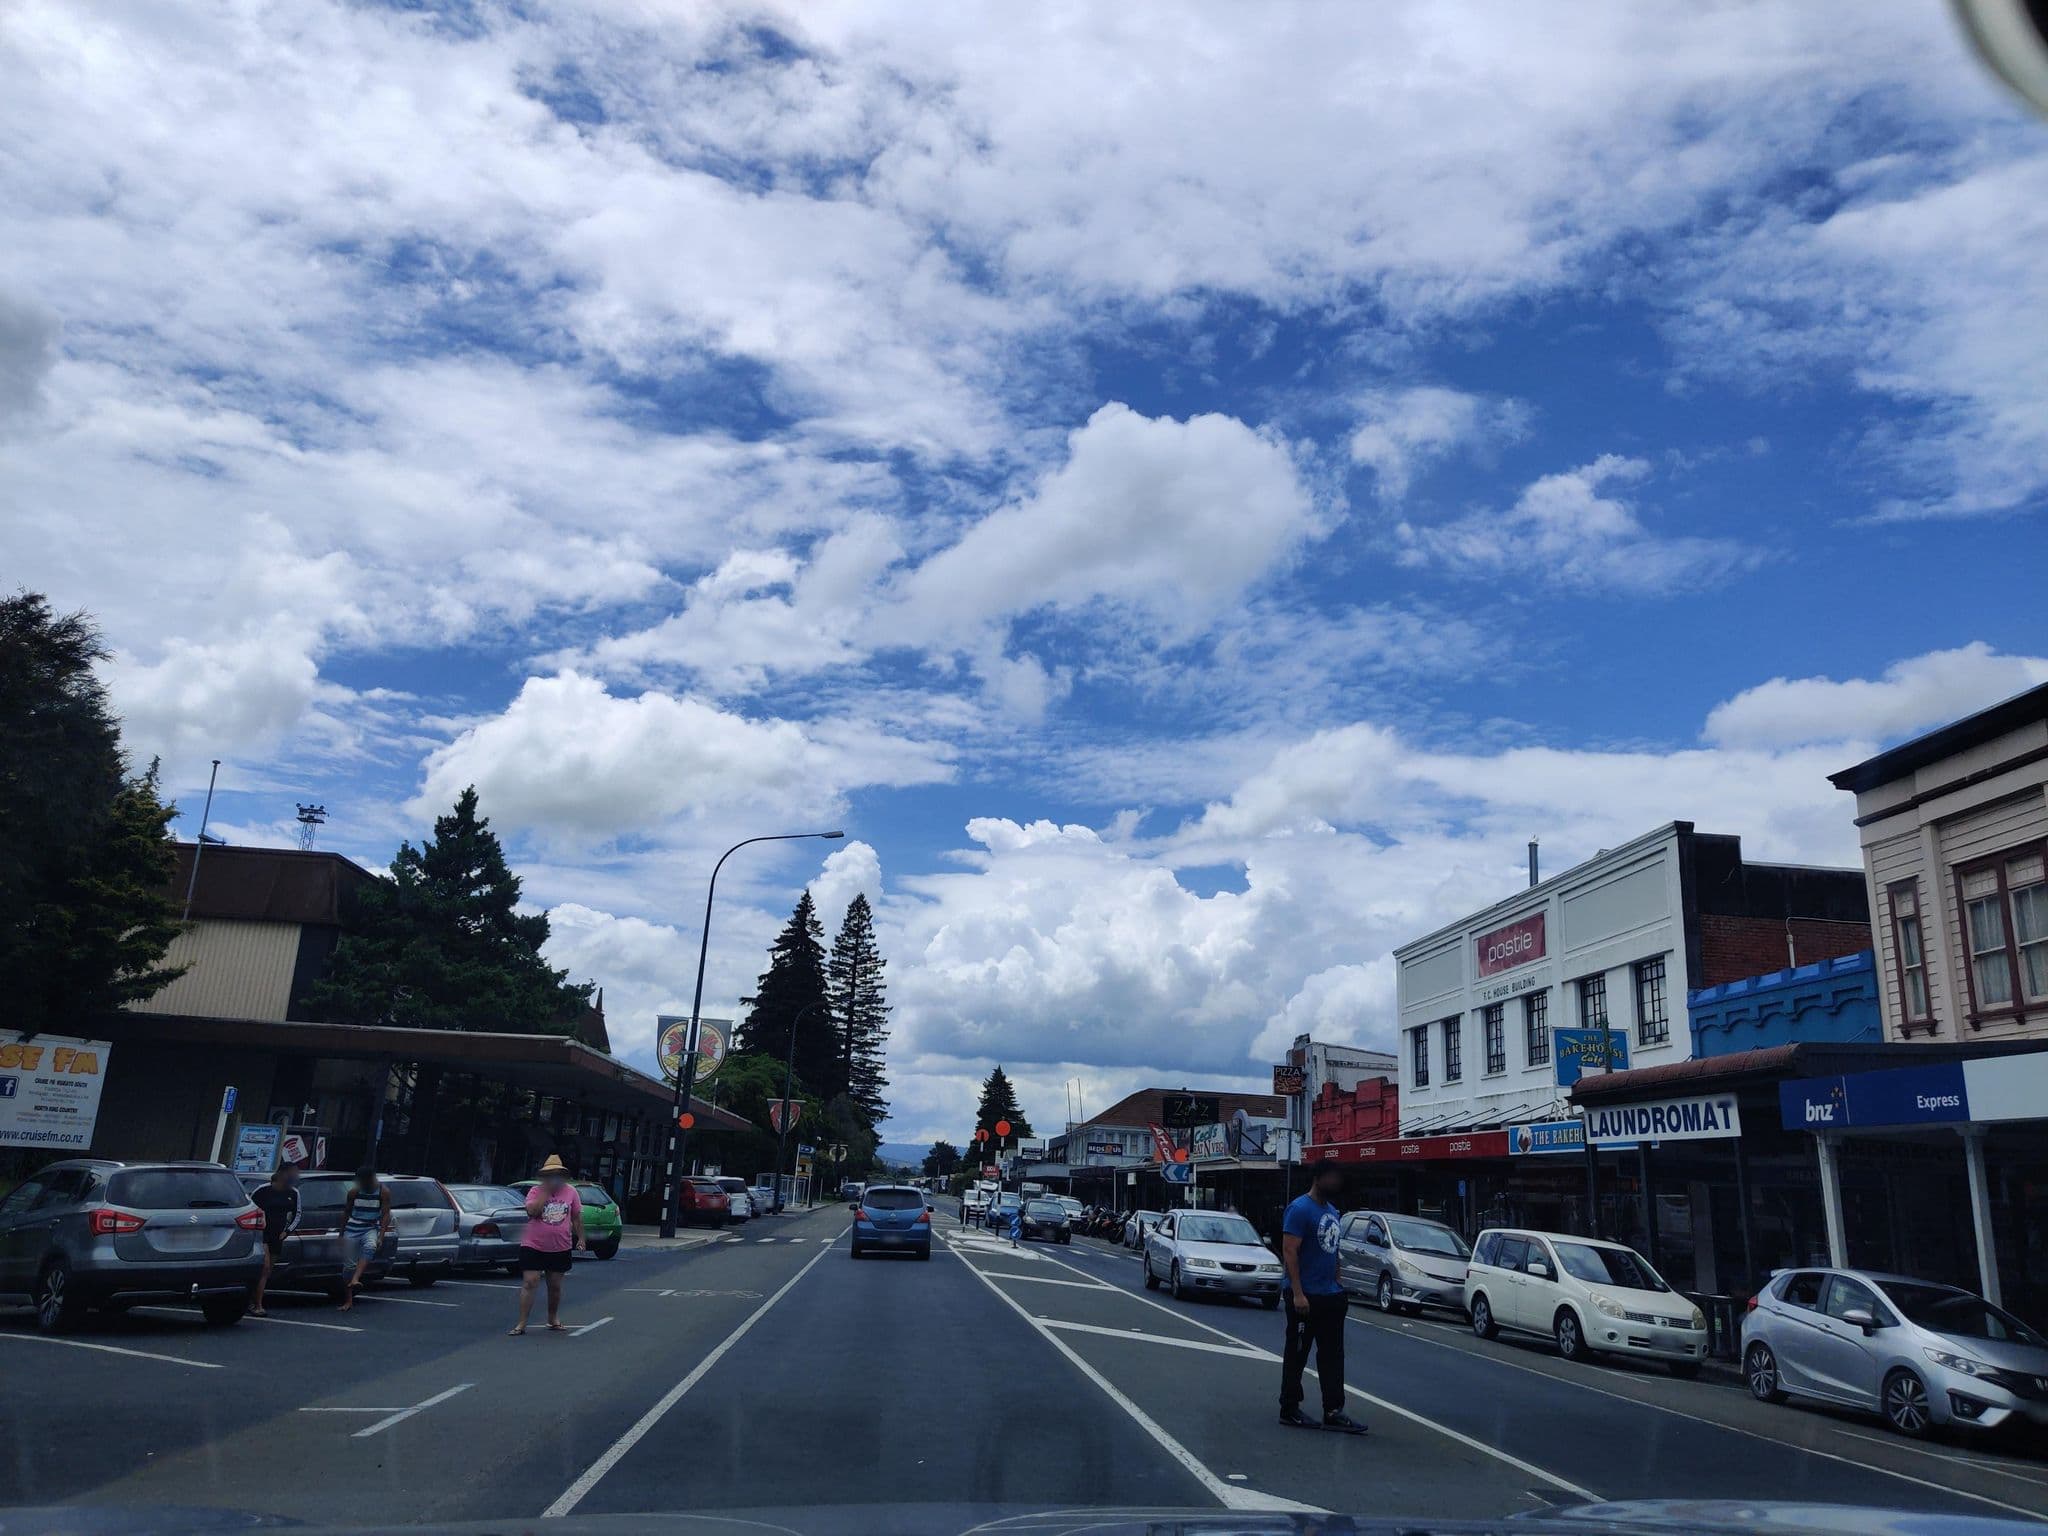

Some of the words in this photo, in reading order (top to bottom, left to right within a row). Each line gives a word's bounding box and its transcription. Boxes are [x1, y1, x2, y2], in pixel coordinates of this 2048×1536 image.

[1488, 929, 1533, 967] postie
[1493, 985, 1509, 998] HOUSE
[1511, 976, 1536, 993] BUILDING
[53, 1047, 98, 1075] FM
[1559, 1043, 1625, 1060] BAKEHOSE
[1275, 1067, 1301, 1077] PIZZA
[1805, 1099, 1834, 1122] bnz
[1916, 1095, 1960, 1111] Express
[1588, 1101, 1732, 1138] LAUNDROMAT
[1533, 1131, 1549, 1145] THE
[1552, 1127, 1584, 1145] BAKEHO
[1088, 1145, 1105, 1153] BEDS
[1112, 1145, 1122, 1153] US
[1360, 1147, 1376, 1157] postie
[1401, 1143, 1420, 1156] postie
[1449, 1138, 1472, 1152] postie
